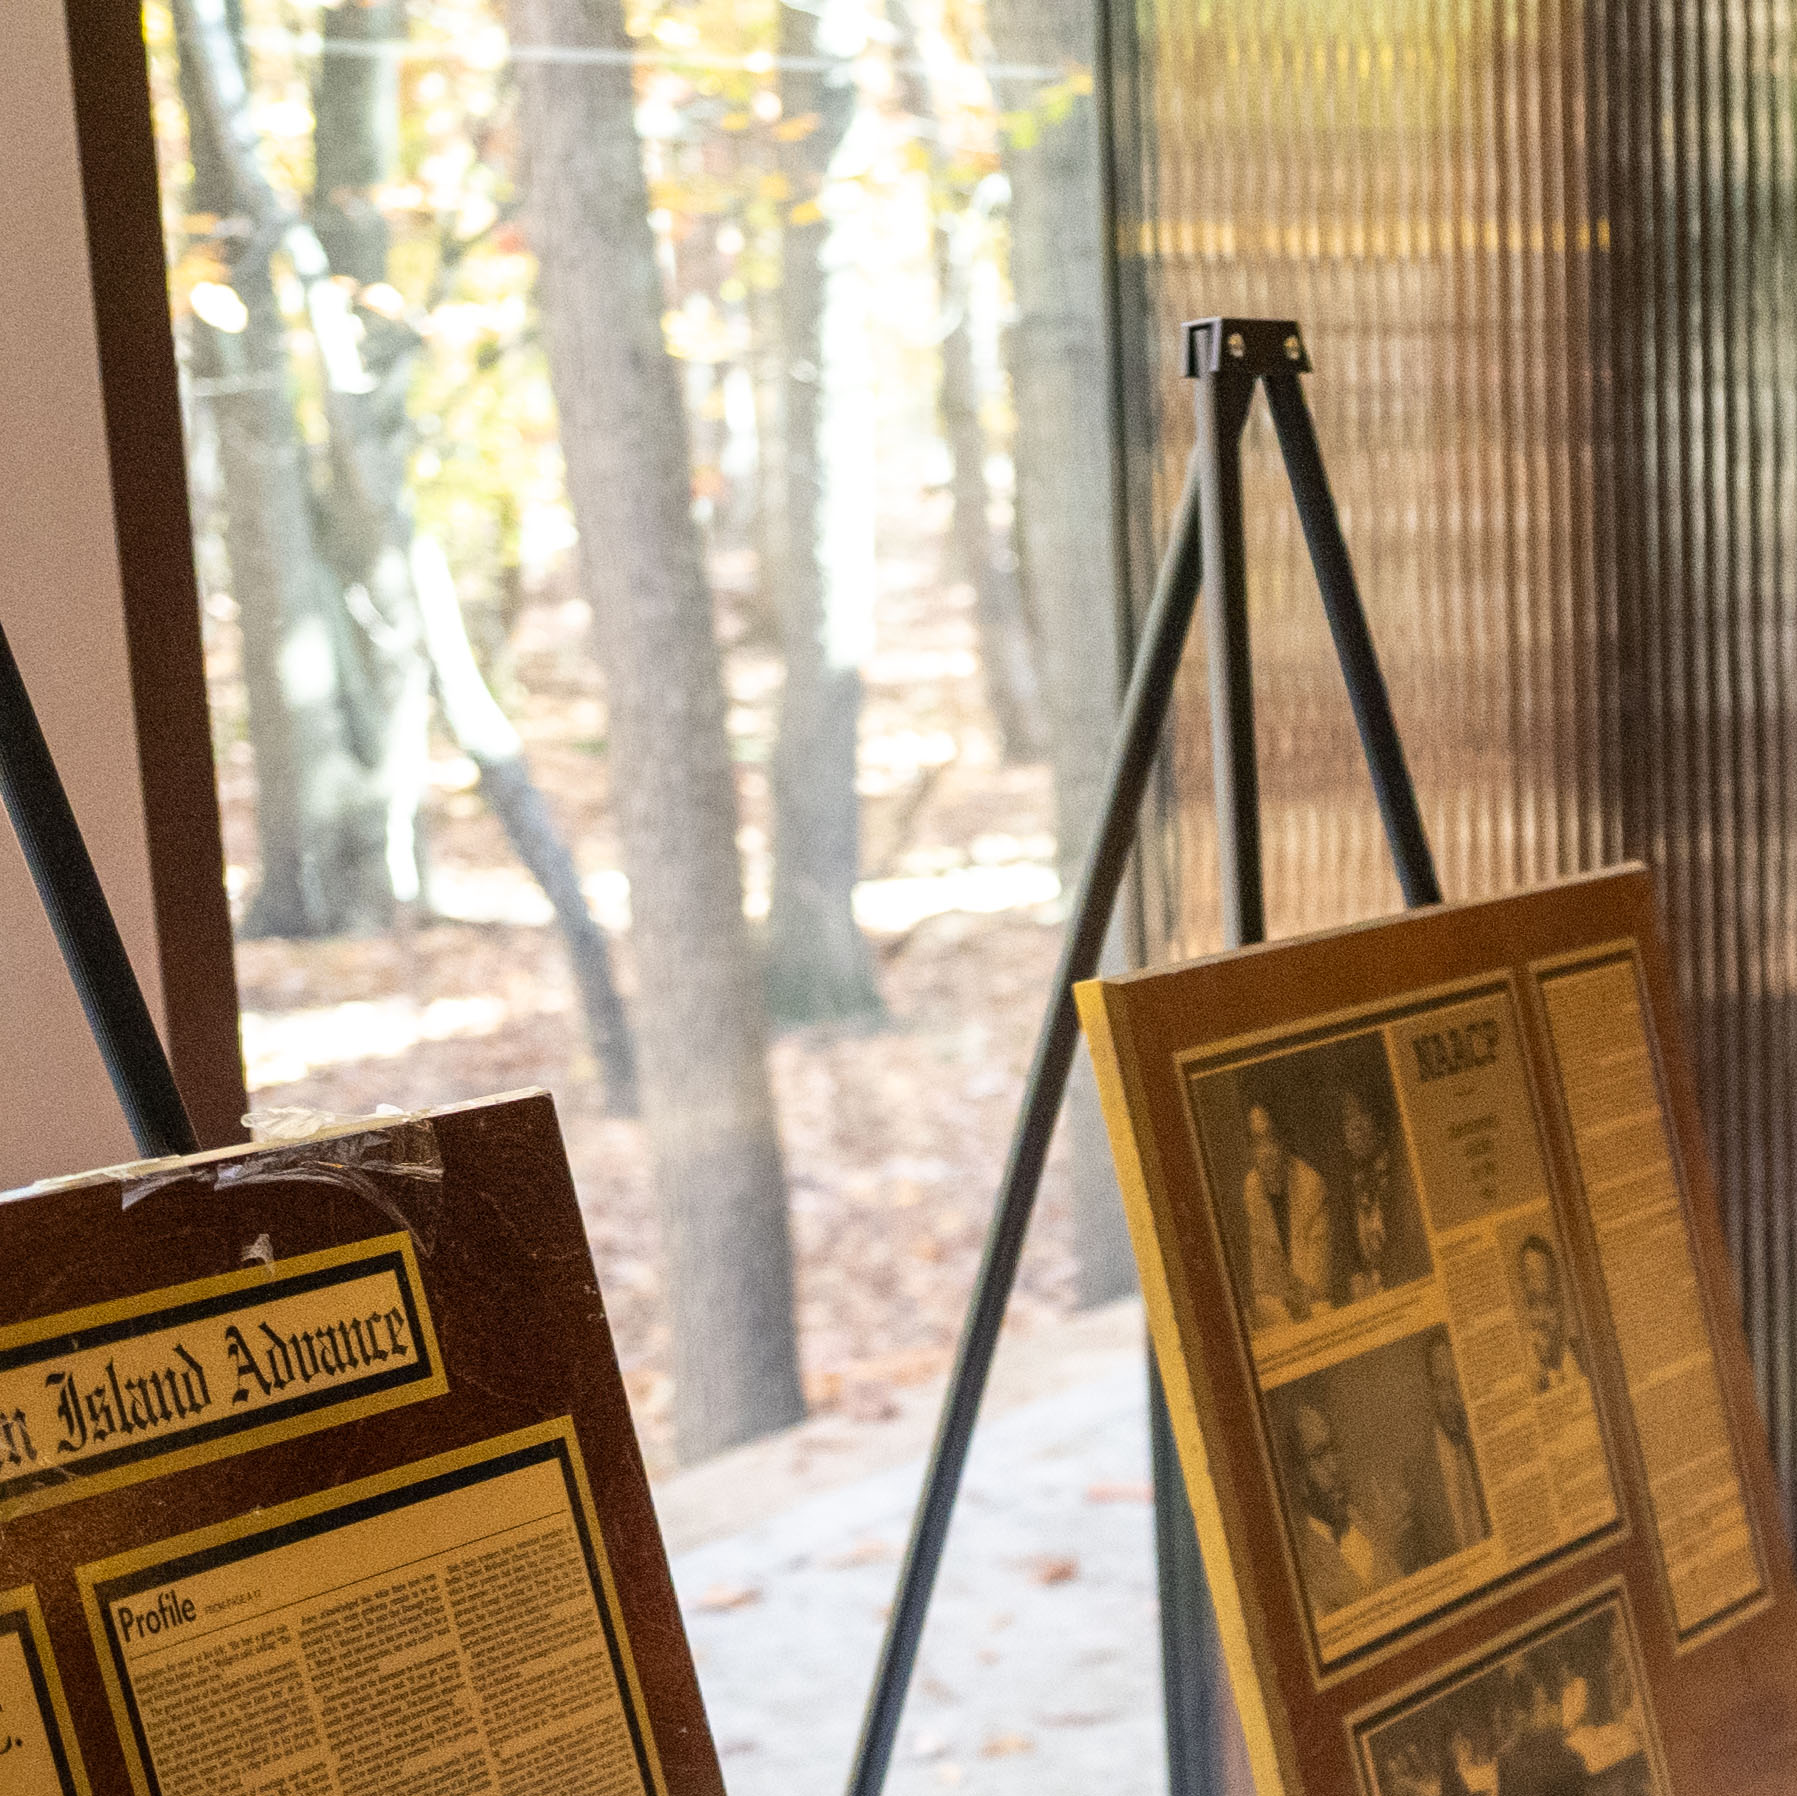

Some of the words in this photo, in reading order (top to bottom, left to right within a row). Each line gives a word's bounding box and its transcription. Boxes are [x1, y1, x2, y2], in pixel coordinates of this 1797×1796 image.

[45, 1343, 210, 1452] Island
[225, 1308, 406, 1403] Advance
[118, 1589, 196, 1642] Profile
